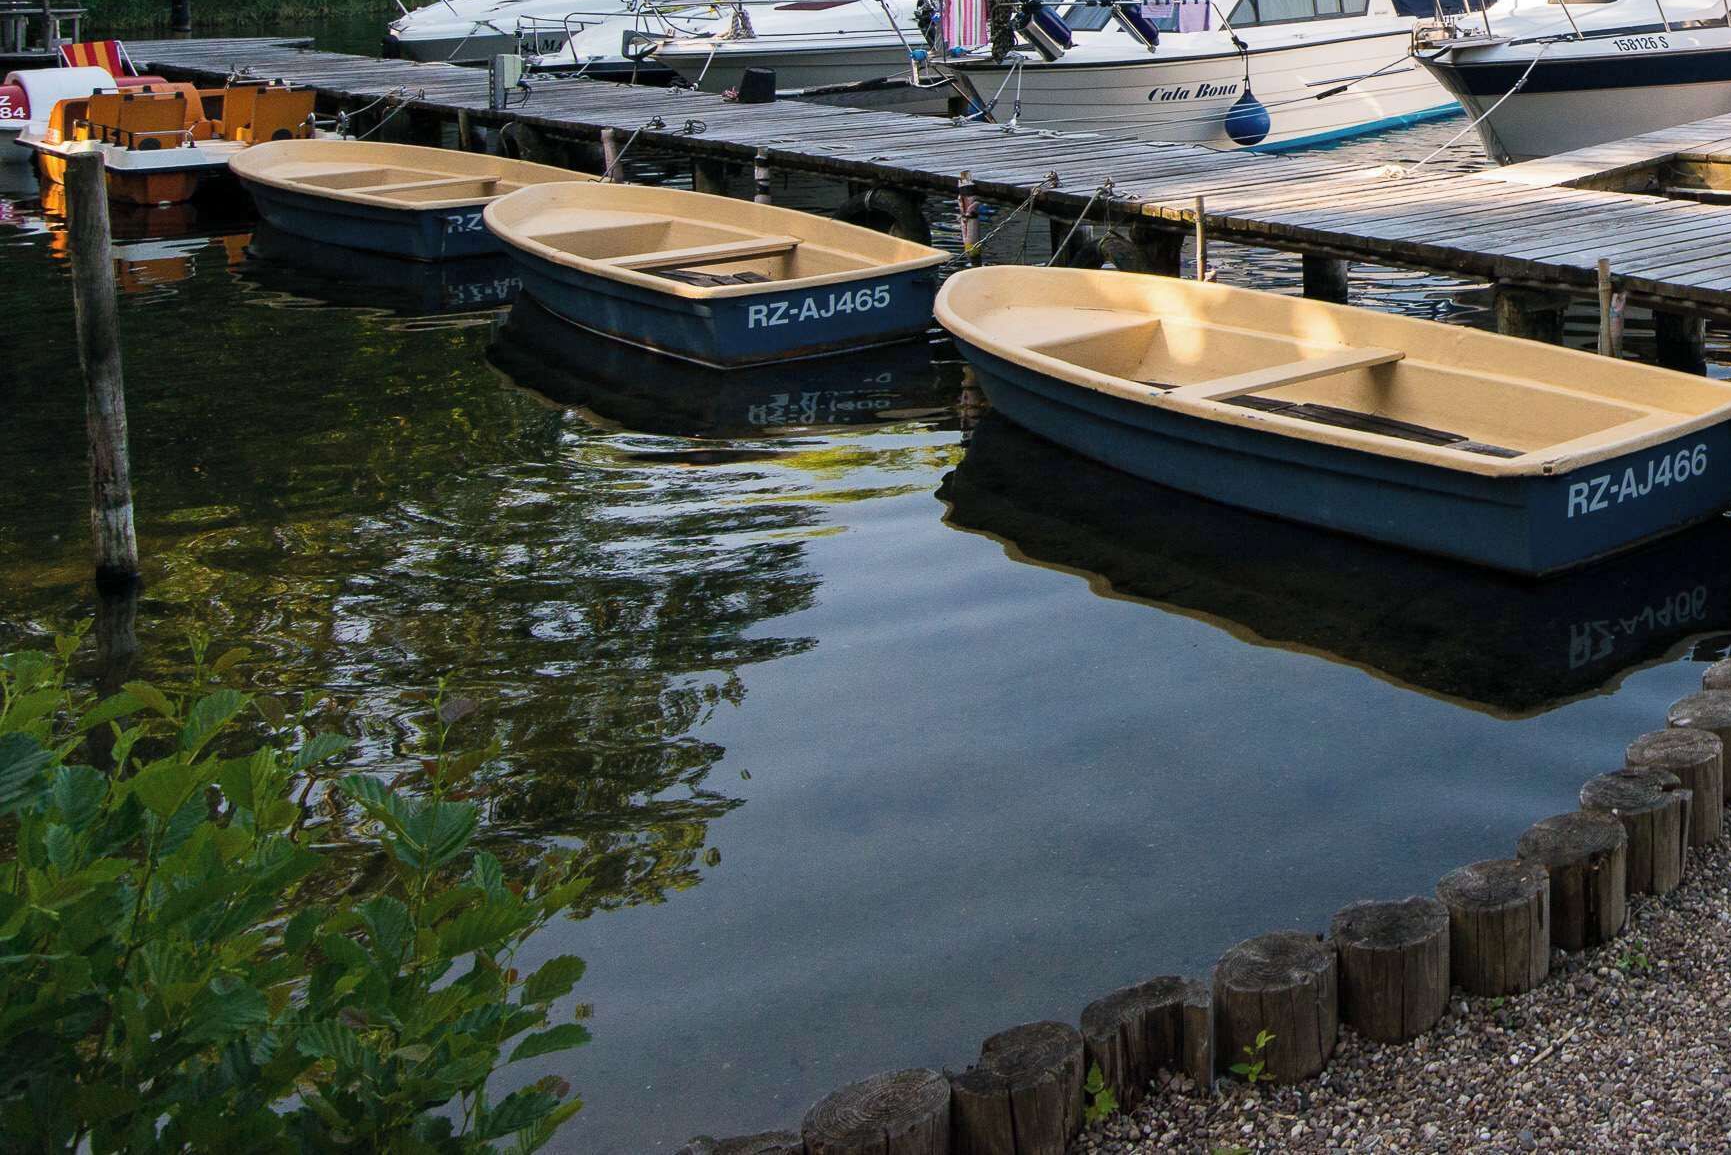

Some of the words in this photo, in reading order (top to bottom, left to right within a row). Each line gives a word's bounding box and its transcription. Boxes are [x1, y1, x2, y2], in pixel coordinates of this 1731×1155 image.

[1612, 36, 1657, 52] 158126
[1659, 36, 1669, 49] S
[1148, 87, 1190, 101] Cala
[1195, 84, 1237, 98] Bona
[748, 284, 890, 329] RZ-AJ465
[1567, 444, 1708, 518] RZ-AJ466
